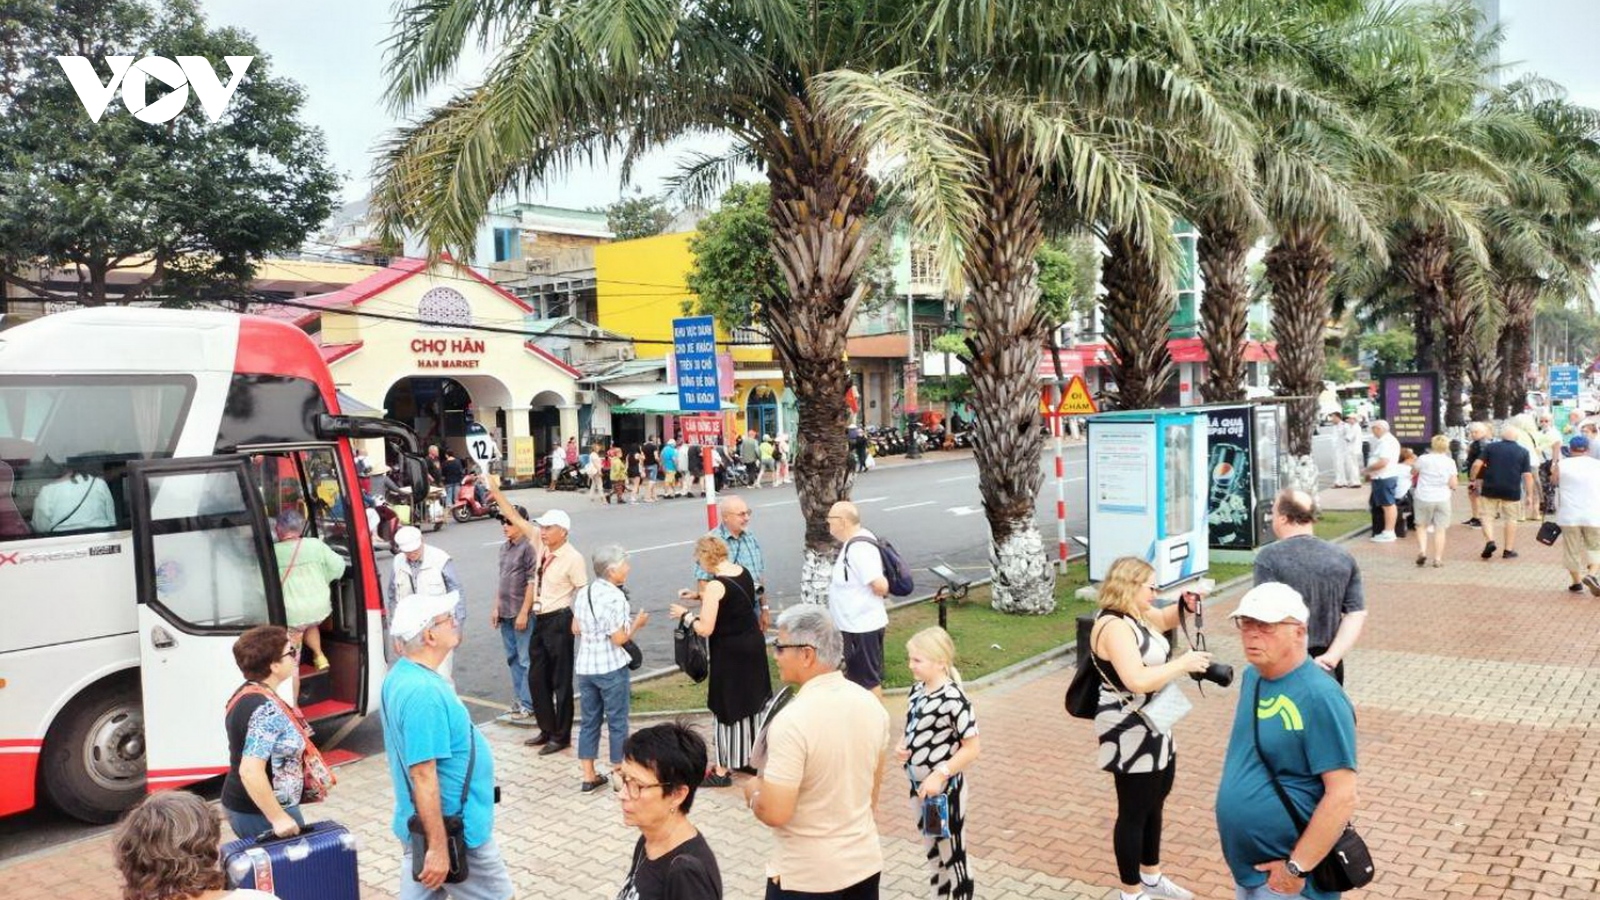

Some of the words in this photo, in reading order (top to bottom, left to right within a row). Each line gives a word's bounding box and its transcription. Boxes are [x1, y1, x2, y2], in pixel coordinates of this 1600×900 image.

[411, 339, 447, 356] CHỢ
[417, 360, 439, 368] HAN
[441, 360, 479, 368] MARKET
[472, 440, 489, 460] 12
